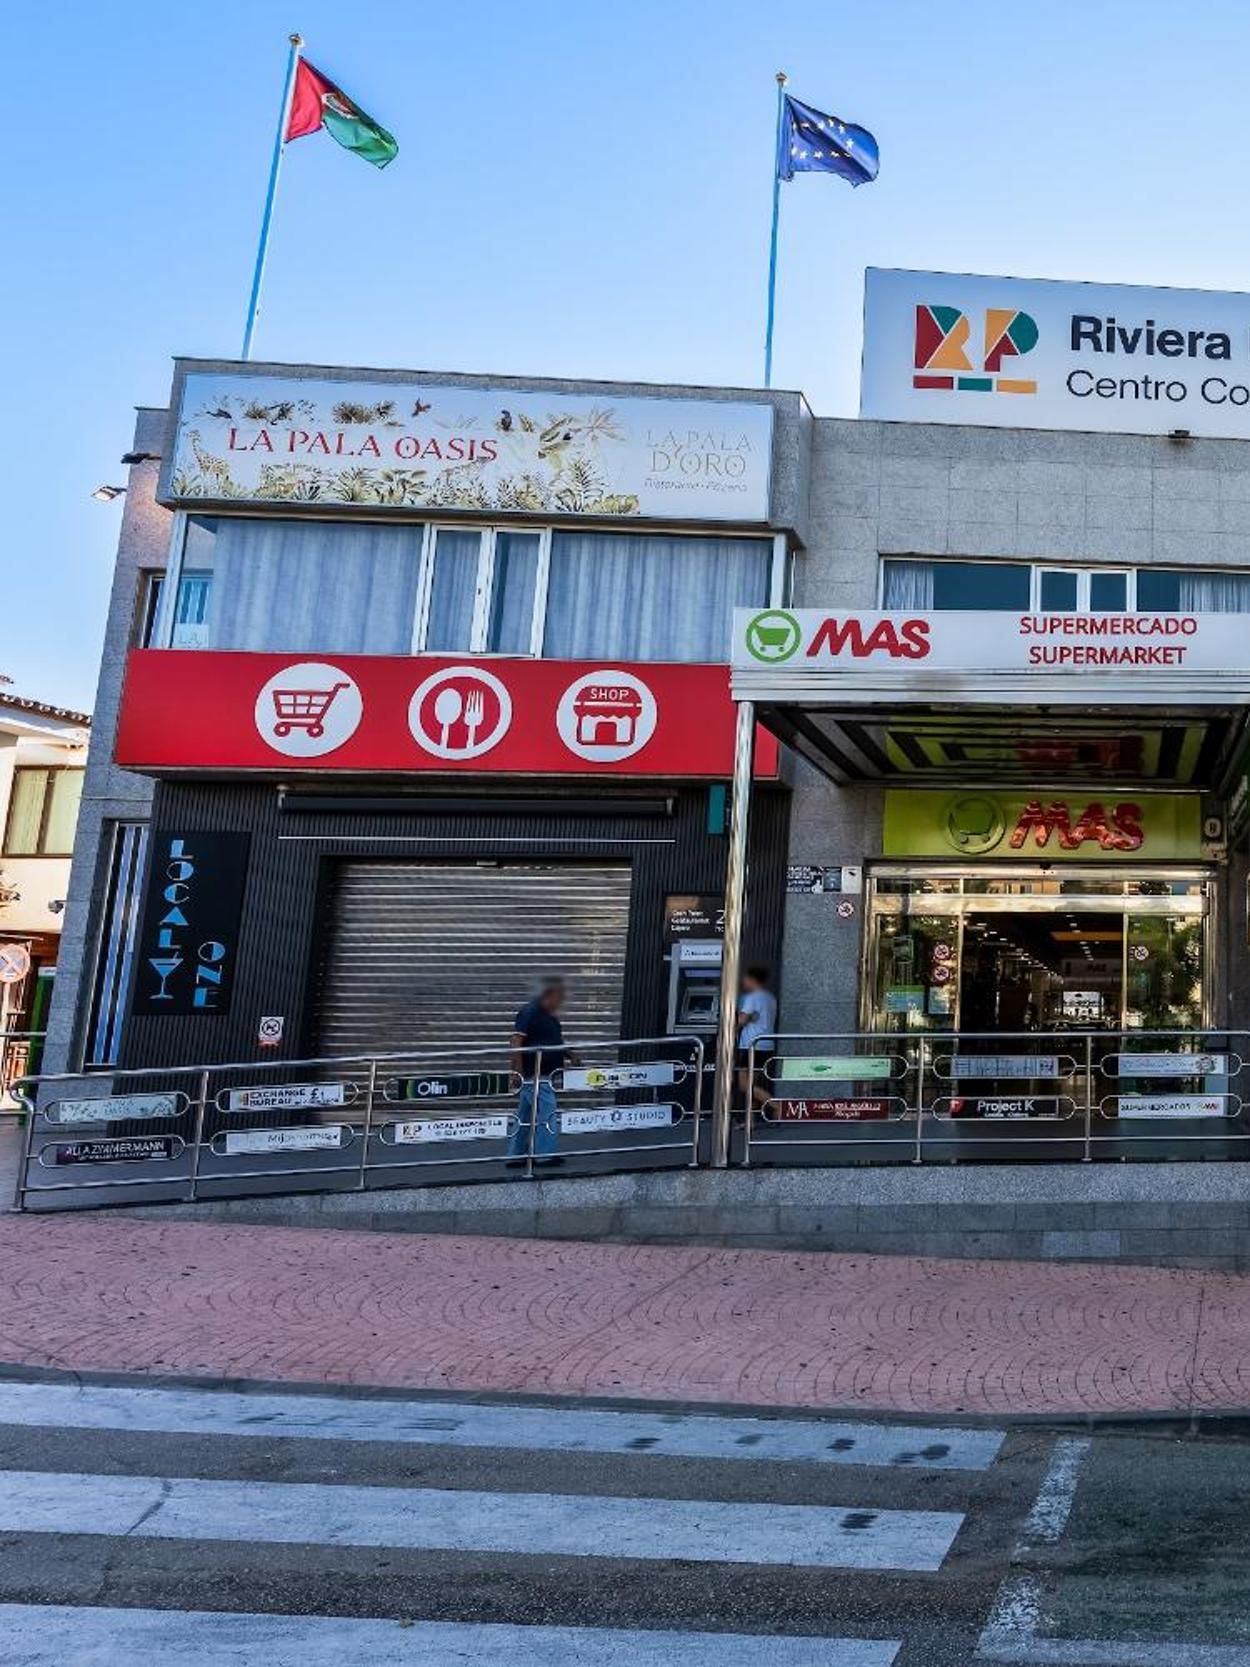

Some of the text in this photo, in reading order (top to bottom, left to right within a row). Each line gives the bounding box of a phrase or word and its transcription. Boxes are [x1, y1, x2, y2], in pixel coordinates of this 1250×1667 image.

[1069, 314, 1231, 361] Riviera
[1066, 369, 1188, 402] Centro
[228, 428, 499, 461] LA PALA OASIS
[687, 430, 752, 451] PALA
[805, 618, 931, 660] MAS
[1019, 616, 1198, 636] SUPERMERCADO
[1028, 645, 1188, 666] SUPERMARKET
[590, 688, 630, 701] SHOP
[1009, 800, 1144, 851] MAS
[158, 839, 194, 949] LOCAL
[193, 941, 226, 1008] ONE
[250, 1088, 306, 1099] EXCHANGE
[977, 1100, 1035, 1112] Project K
[568, 1115, 606, 1126] BEAUTY
[626, 1111, 666, 1120] STUDIO
